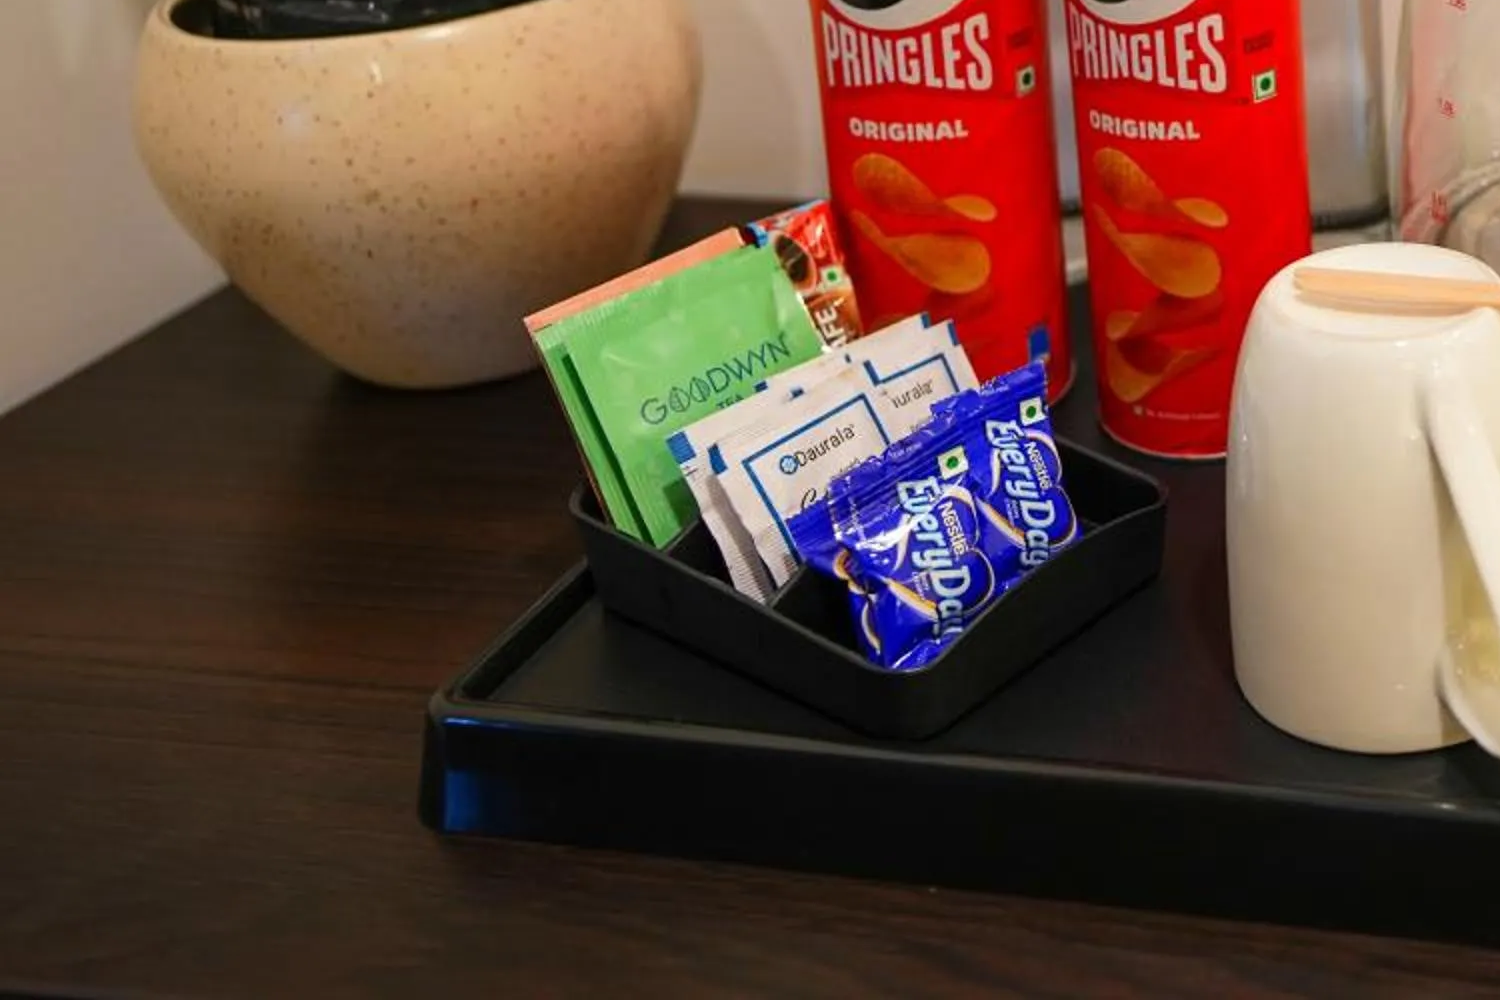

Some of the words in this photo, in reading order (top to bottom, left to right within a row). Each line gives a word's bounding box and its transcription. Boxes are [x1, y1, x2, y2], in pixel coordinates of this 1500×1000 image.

[822, 9, 993, 91] PRINGLES
[1069, 1, 1227, 93] PRINGLES
[849, 117, 969, 142] ORIGINAL
[1089, 109, 1201, 141] ORIGINAL
[640, 331, 792, 426] GOODWYN
[793, 424, 856, 468] Daurala
[985, 418, 1055, 566] EveryDay
